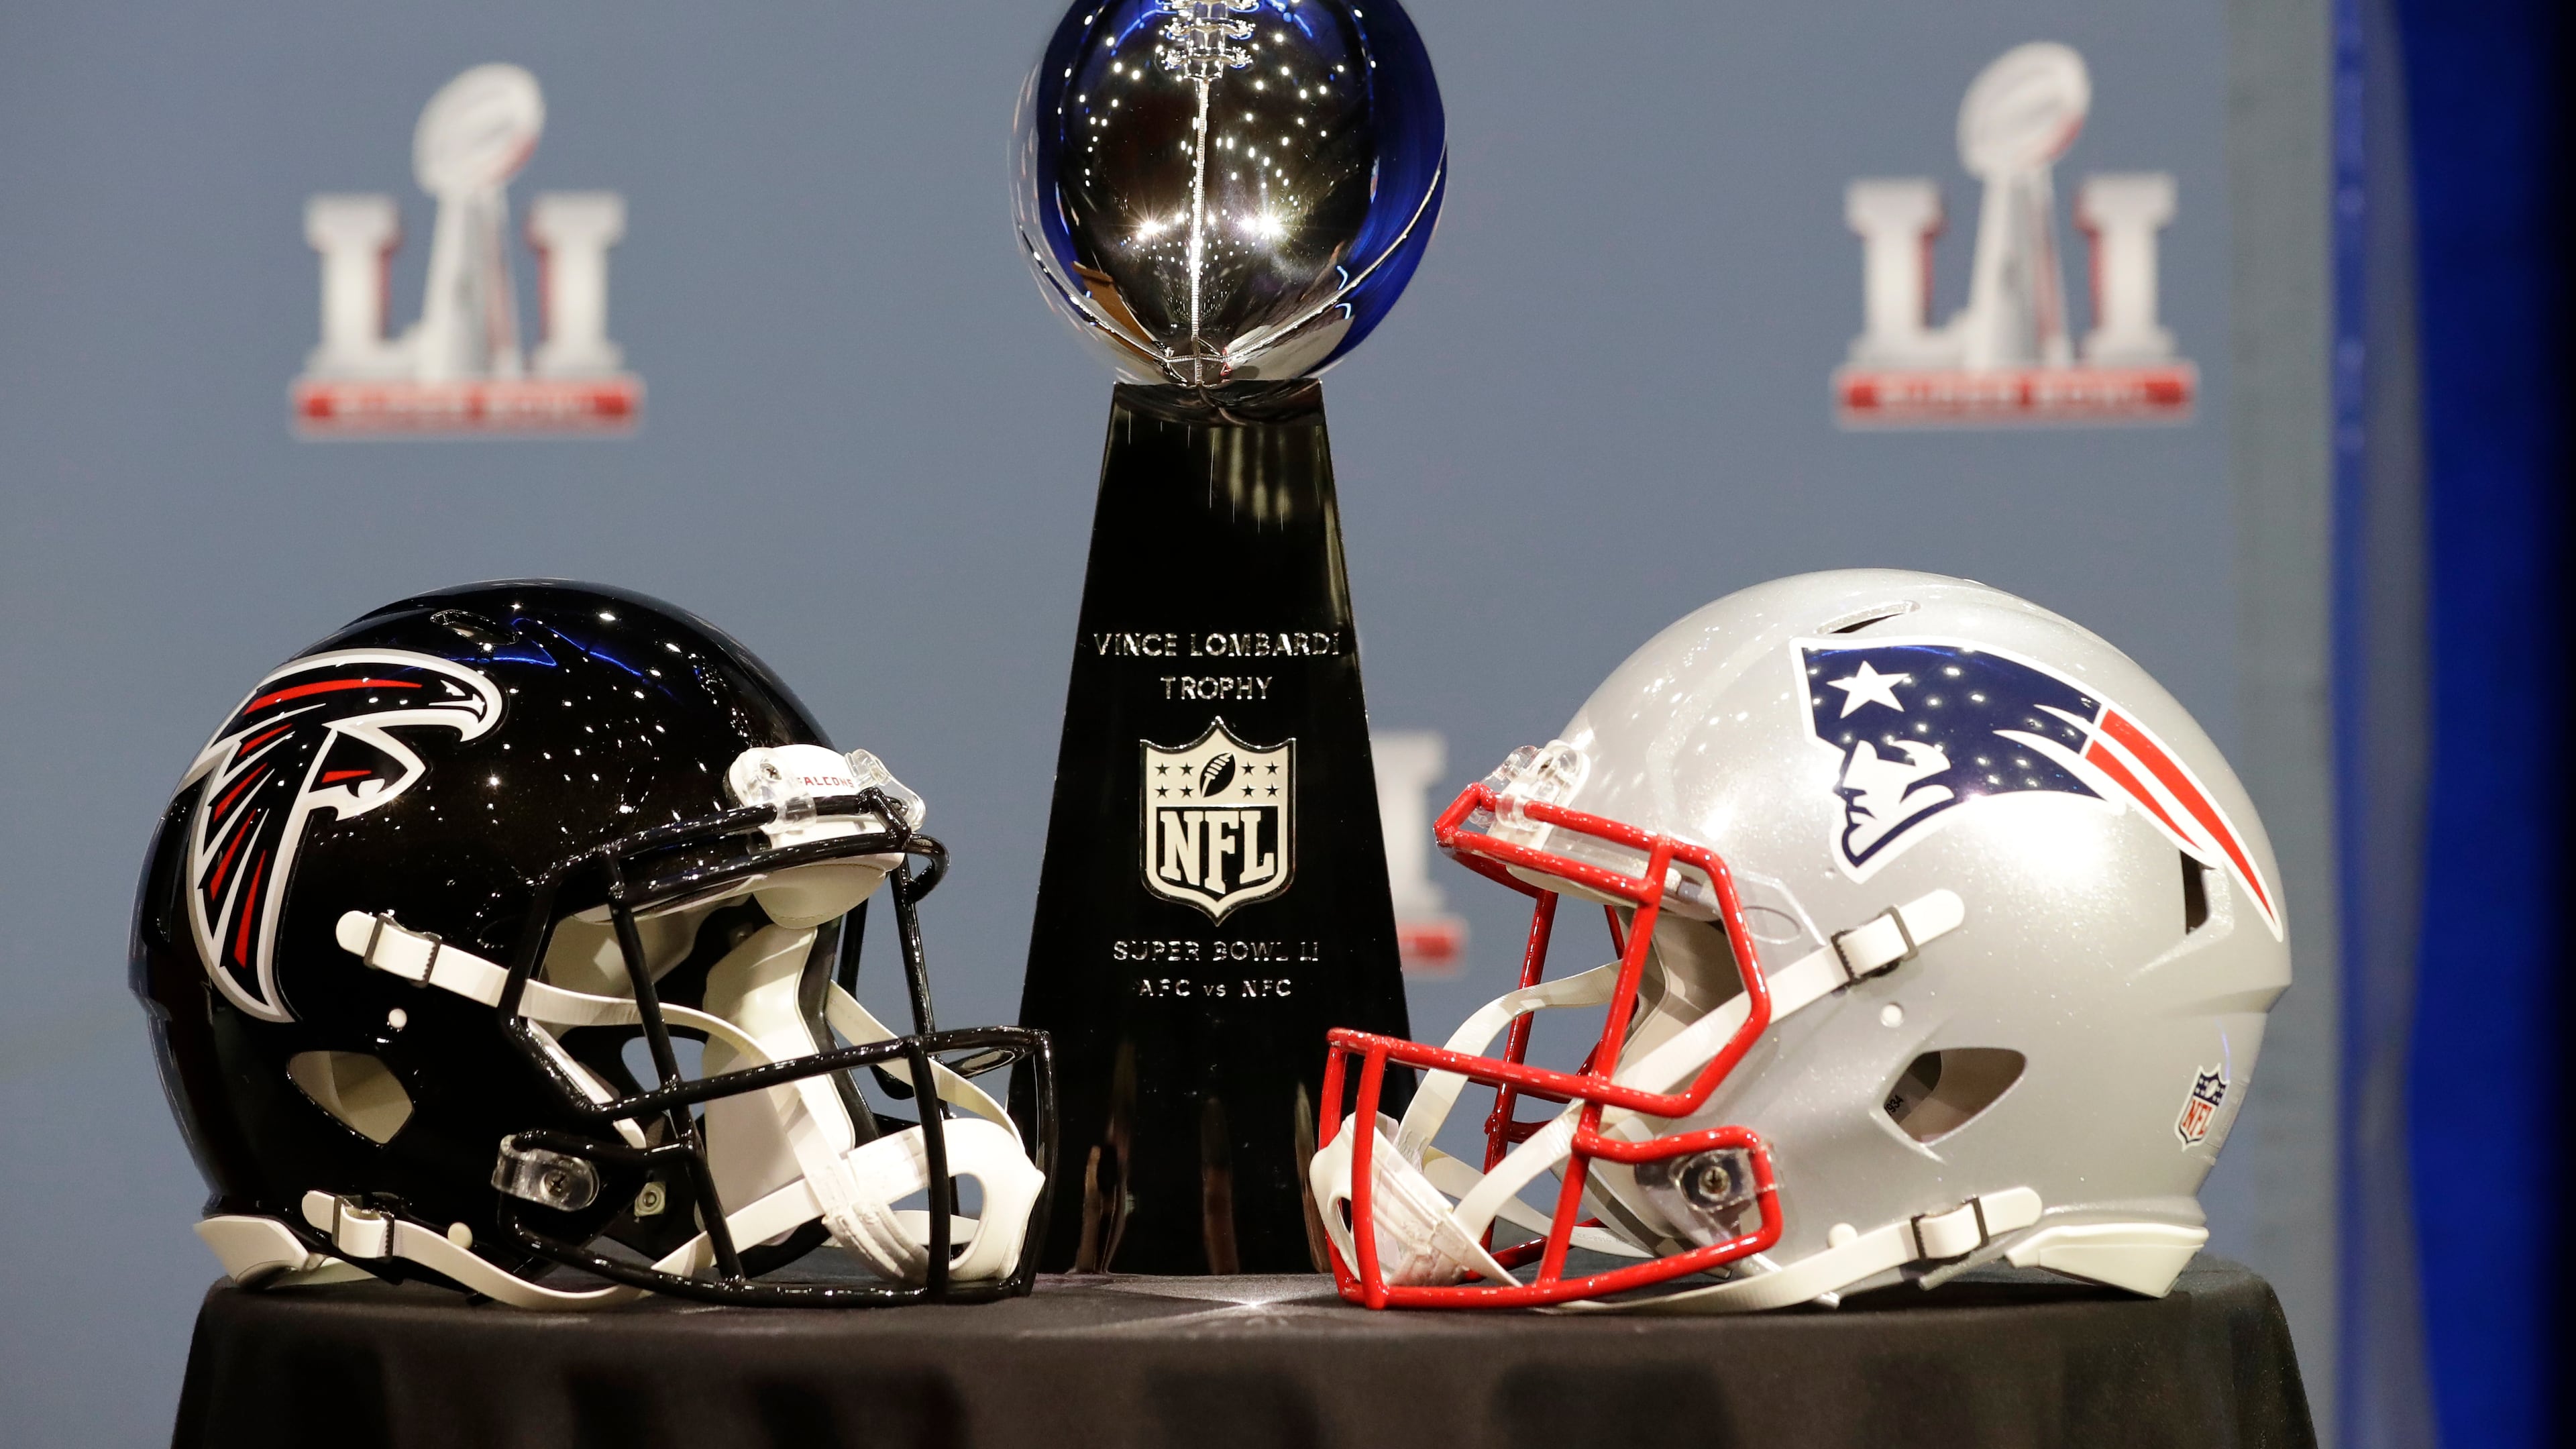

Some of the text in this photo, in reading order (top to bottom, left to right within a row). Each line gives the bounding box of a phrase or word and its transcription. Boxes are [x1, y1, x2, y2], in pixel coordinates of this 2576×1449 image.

[1093, 632, 1340, 657] VINCE LOMBARDI
[1160, 676, 1273, 700] TROPHY
[1159, 810, 1275, 895] NFL
[1113, 941, 1319, 962] SUPER BOWL LI
[1139, 978, 1291, 998] AFC vs NFC
